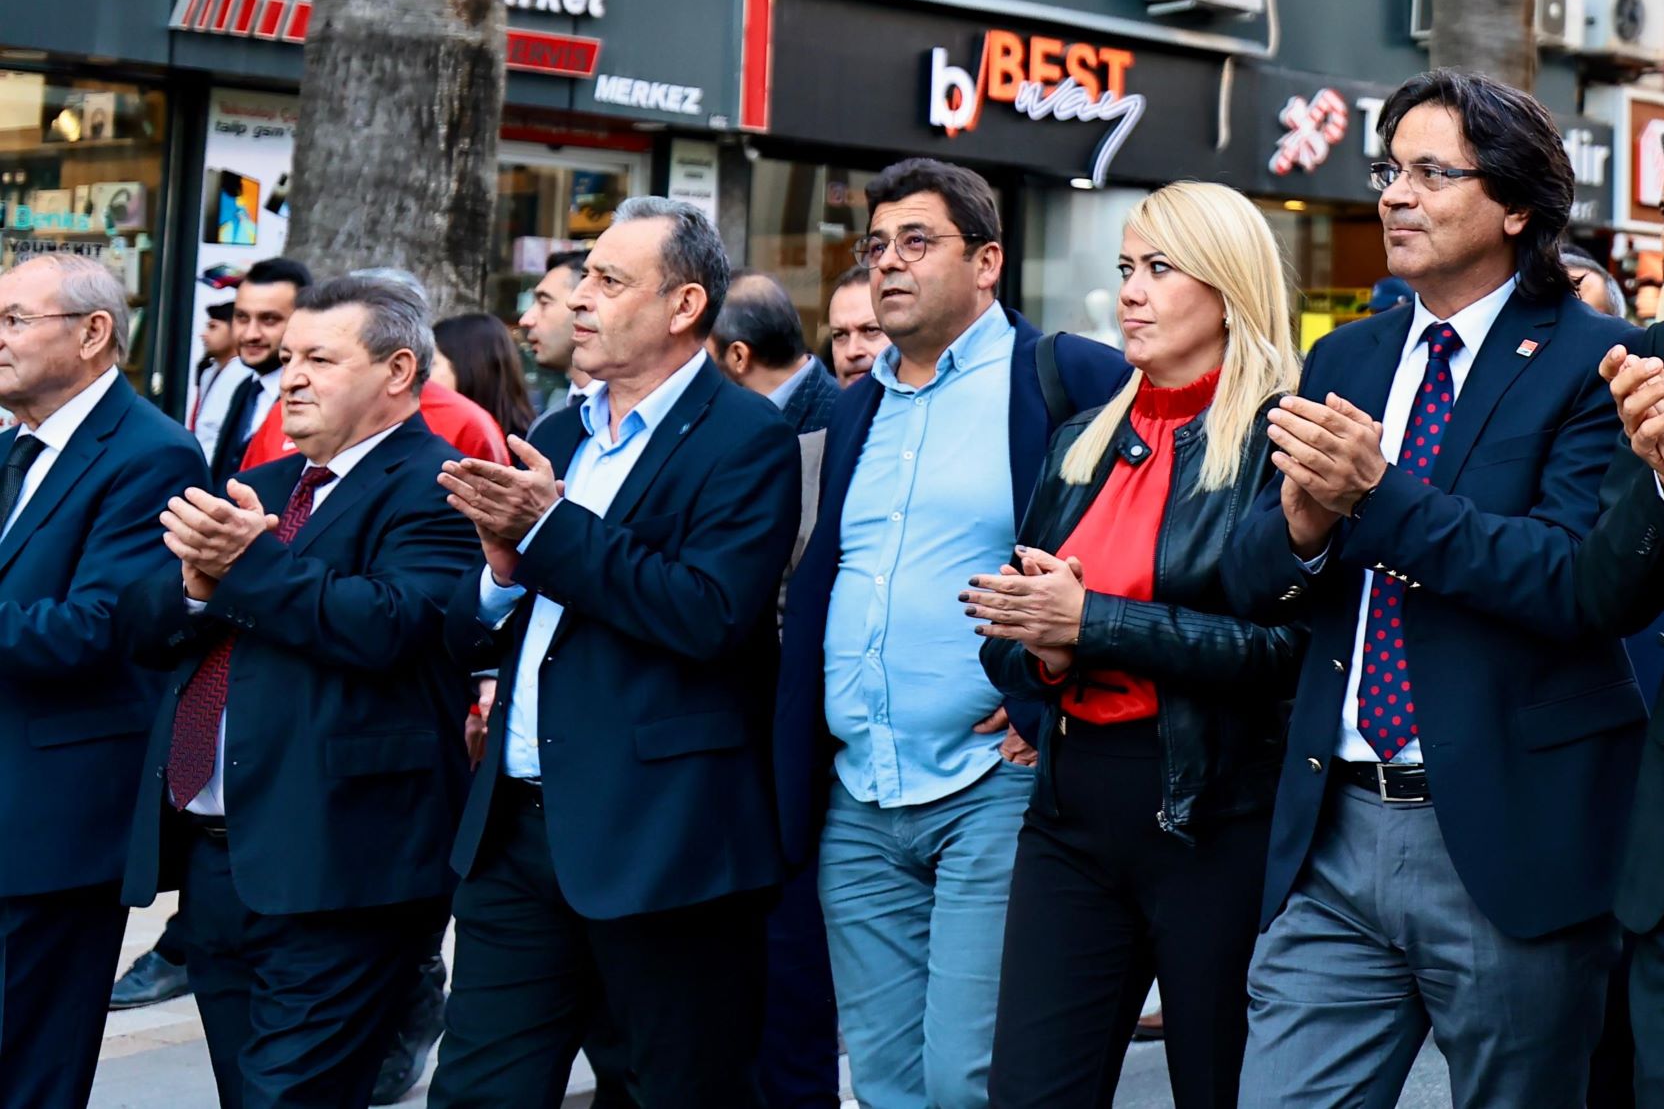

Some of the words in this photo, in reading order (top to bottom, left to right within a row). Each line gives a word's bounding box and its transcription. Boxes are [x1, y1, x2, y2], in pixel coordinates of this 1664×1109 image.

[986, 28, 1136, 105] BEST
[593, 73, 704, 116] MERKEZ
[215, 120, 247, 137] talip
